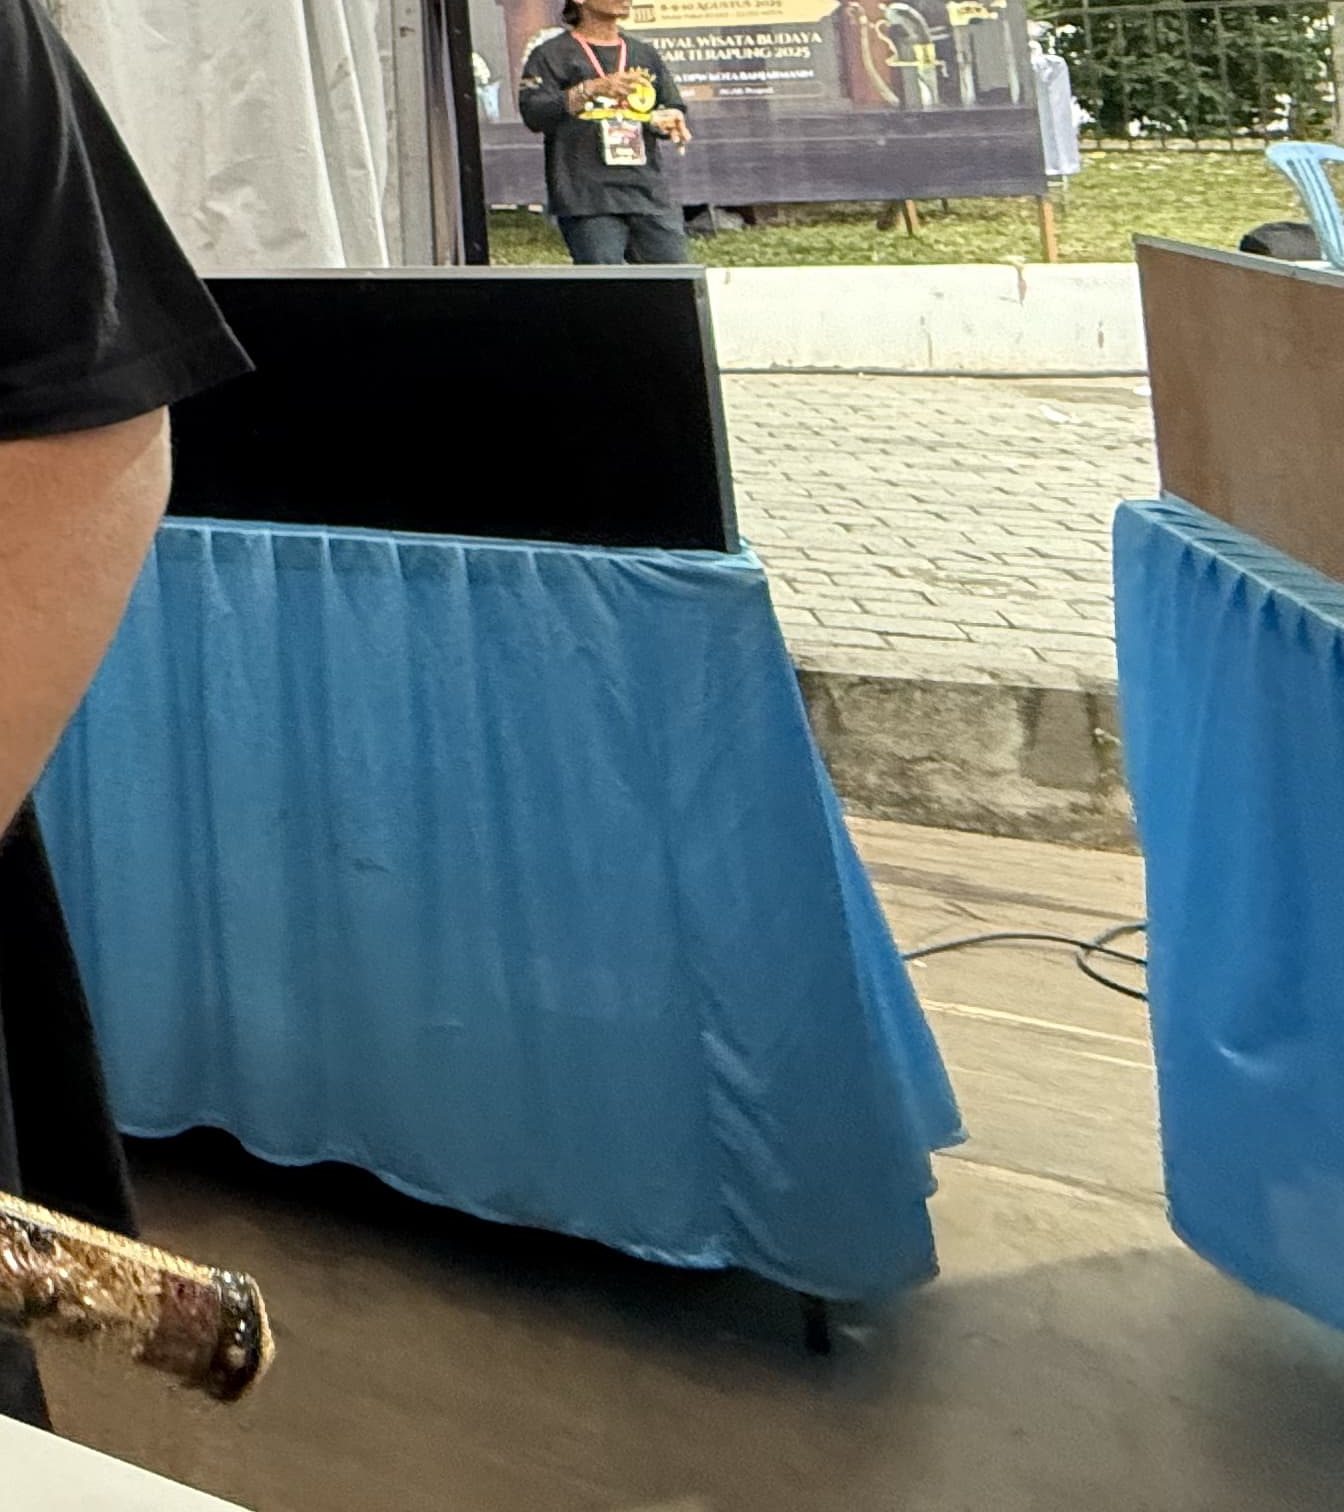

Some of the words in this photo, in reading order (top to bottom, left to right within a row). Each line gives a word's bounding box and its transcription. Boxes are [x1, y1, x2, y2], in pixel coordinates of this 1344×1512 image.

[696, 33, 755, 48] WISATA
[756, 31, 822, 46] BUDAYA
[688, 46, 772, 62] TERAPUNG
[774, 45, 811, 59] 2025
